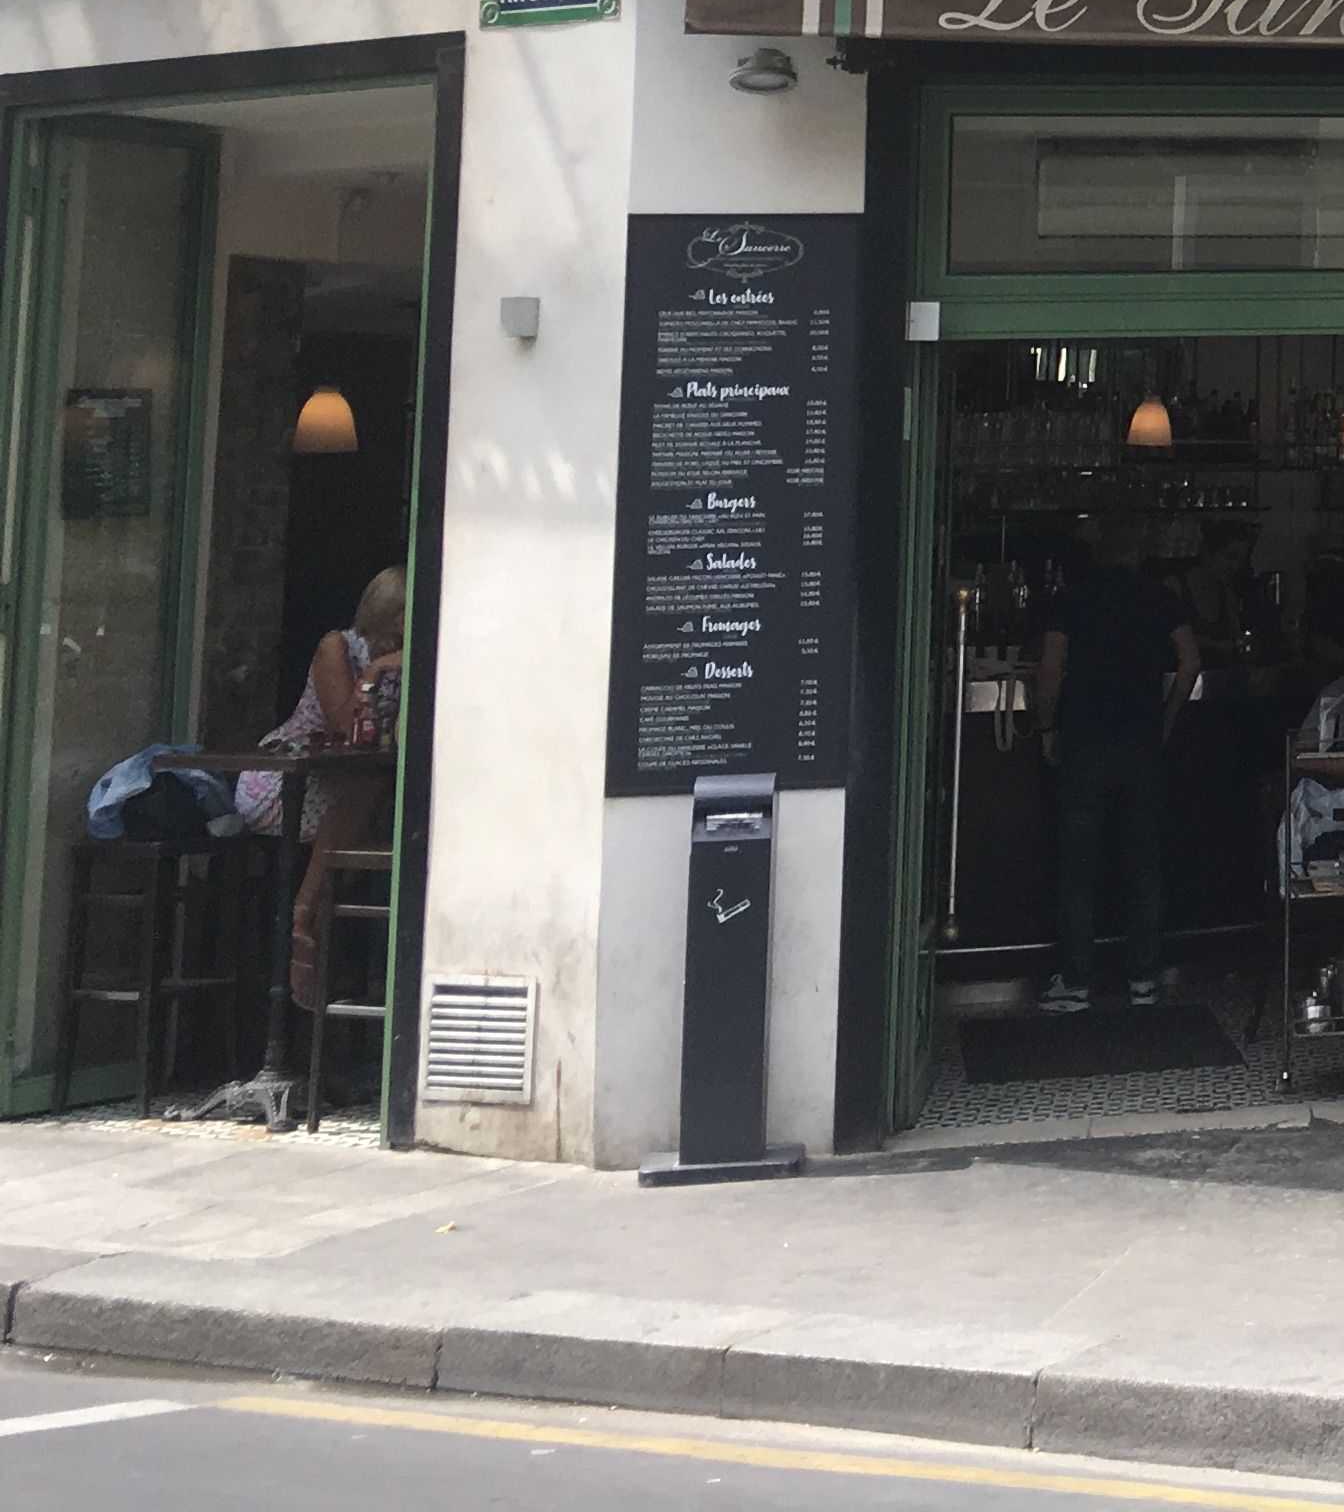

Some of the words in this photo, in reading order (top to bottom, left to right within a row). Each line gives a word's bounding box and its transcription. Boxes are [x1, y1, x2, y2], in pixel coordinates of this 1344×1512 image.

[708, 288, 728, 305] Les
[686, 381, 718, 399] Plats
[720, 383, 790, 402] principaux
[707, 491, 757, 513] Burgers
[705, 551, 757, 571] Salades
[702, 616, 762, 637] Fromages
[704, 661, 754, 680] Desserts
